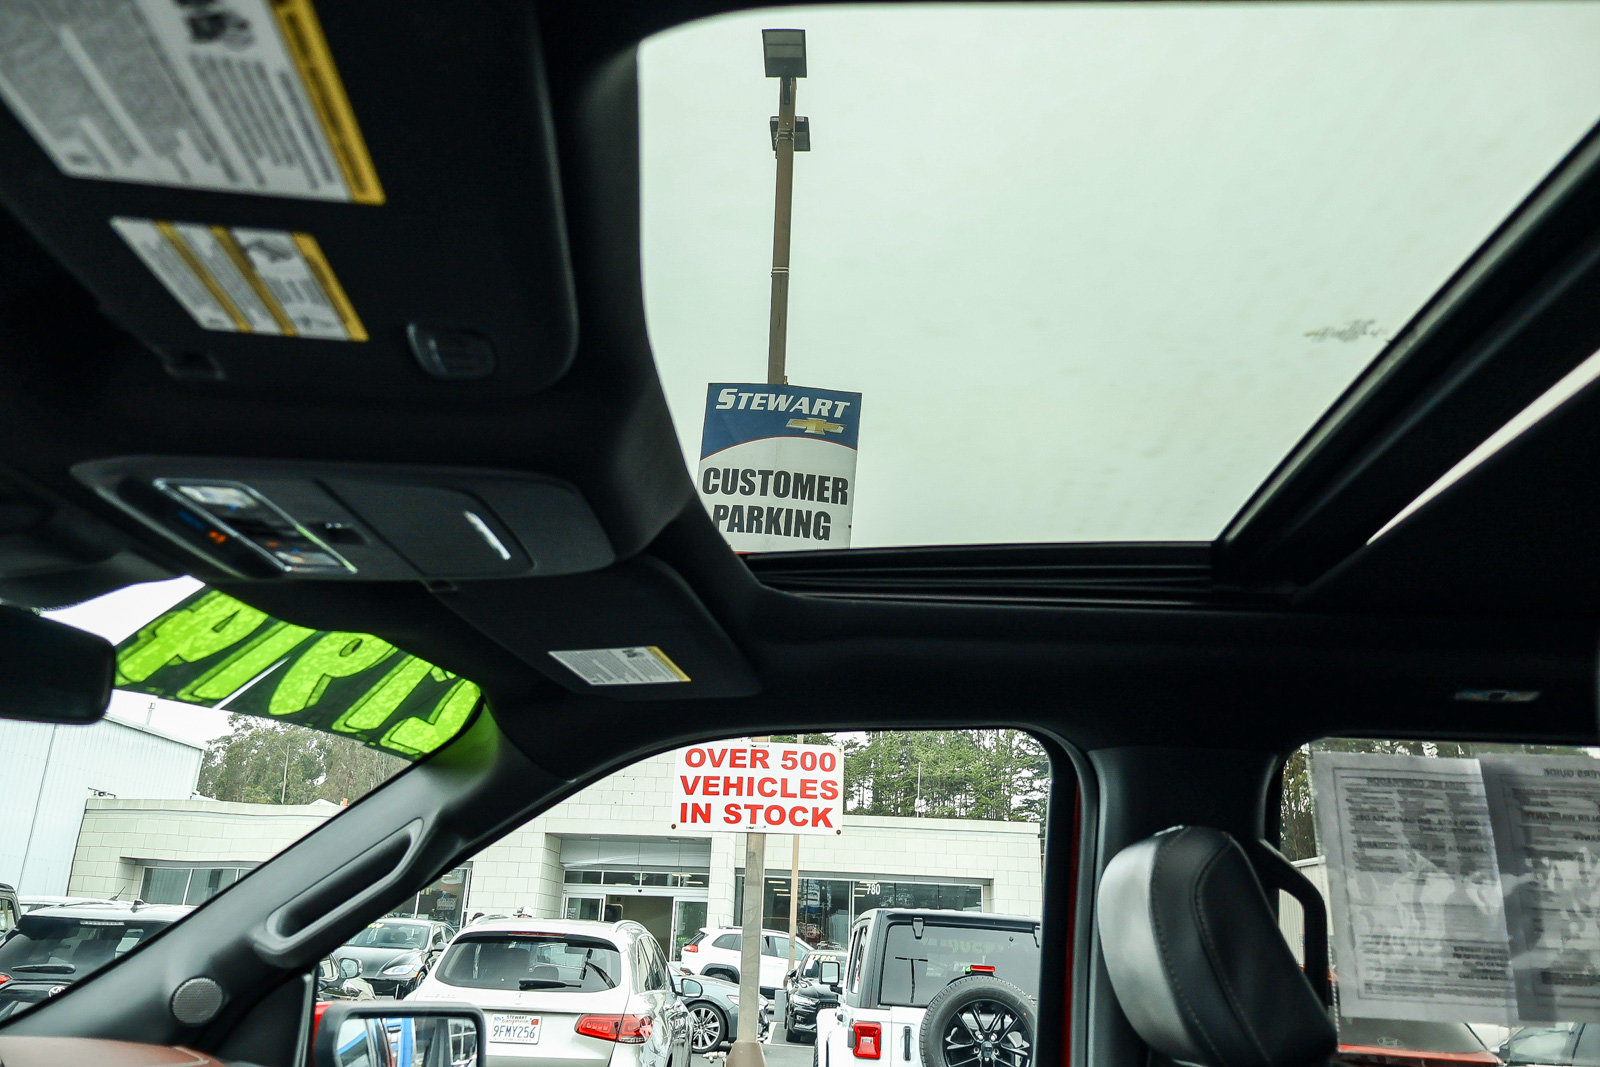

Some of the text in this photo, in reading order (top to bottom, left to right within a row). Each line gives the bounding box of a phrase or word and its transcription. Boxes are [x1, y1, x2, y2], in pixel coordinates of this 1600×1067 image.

[715, 388, 850, 418] STEWART
[702, 467, 849, 506] CUSTOMER
[712, 504, 831, 541] PARKING
[685, 748, 836, 772] OVER 500
[680, 775, 839, 800] VEHICLES
[680, 802, 834, 828] IN STOCK
[866, 883, 880, 895] 780
[493, 1025, 536, 1039] 9FMY256
